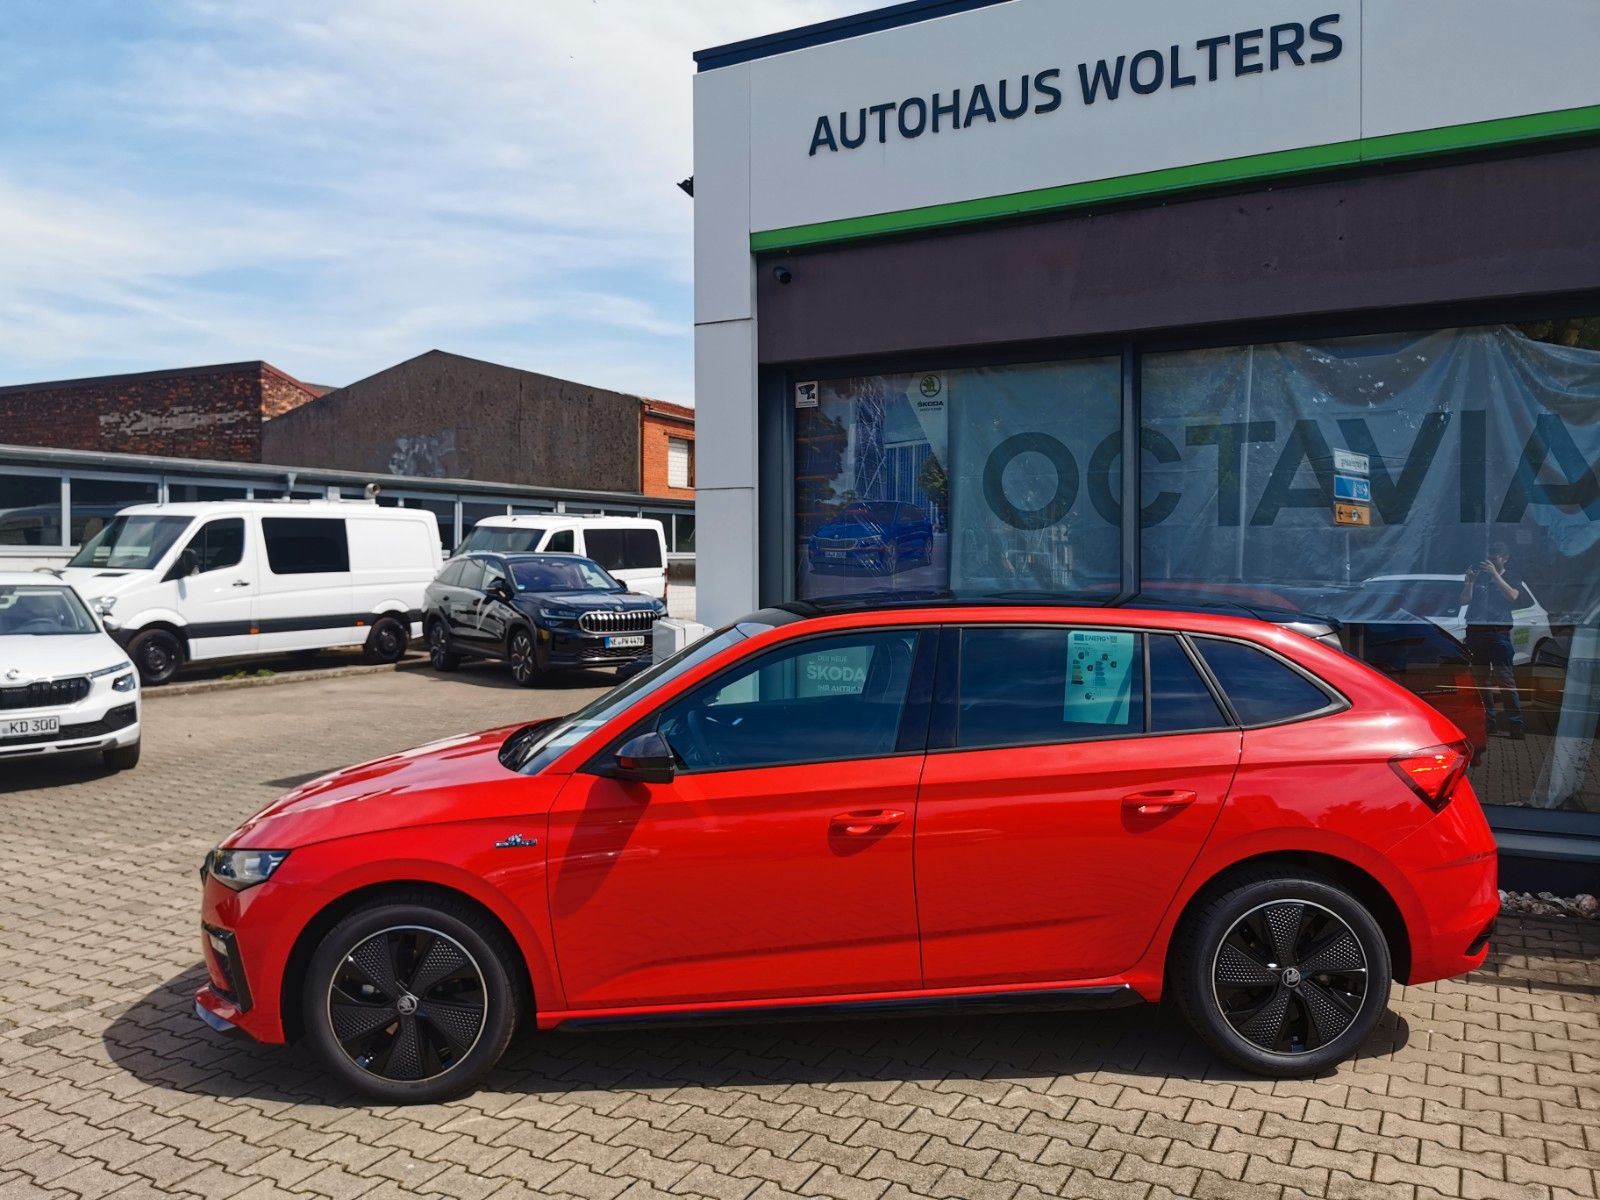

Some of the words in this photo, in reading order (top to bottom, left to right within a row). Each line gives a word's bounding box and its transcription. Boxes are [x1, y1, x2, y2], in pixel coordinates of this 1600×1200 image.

[808, 69, 1062, 157] AUTOHAUS
[1078, 13, 1343, 105] WOLTERS
[982, 409, 1600, 532] OCTAVIA
[806, 661, 866, 682] ŠKODA
[10, 721, 29, 733] KD
[32, 719, 57, 732] 300
